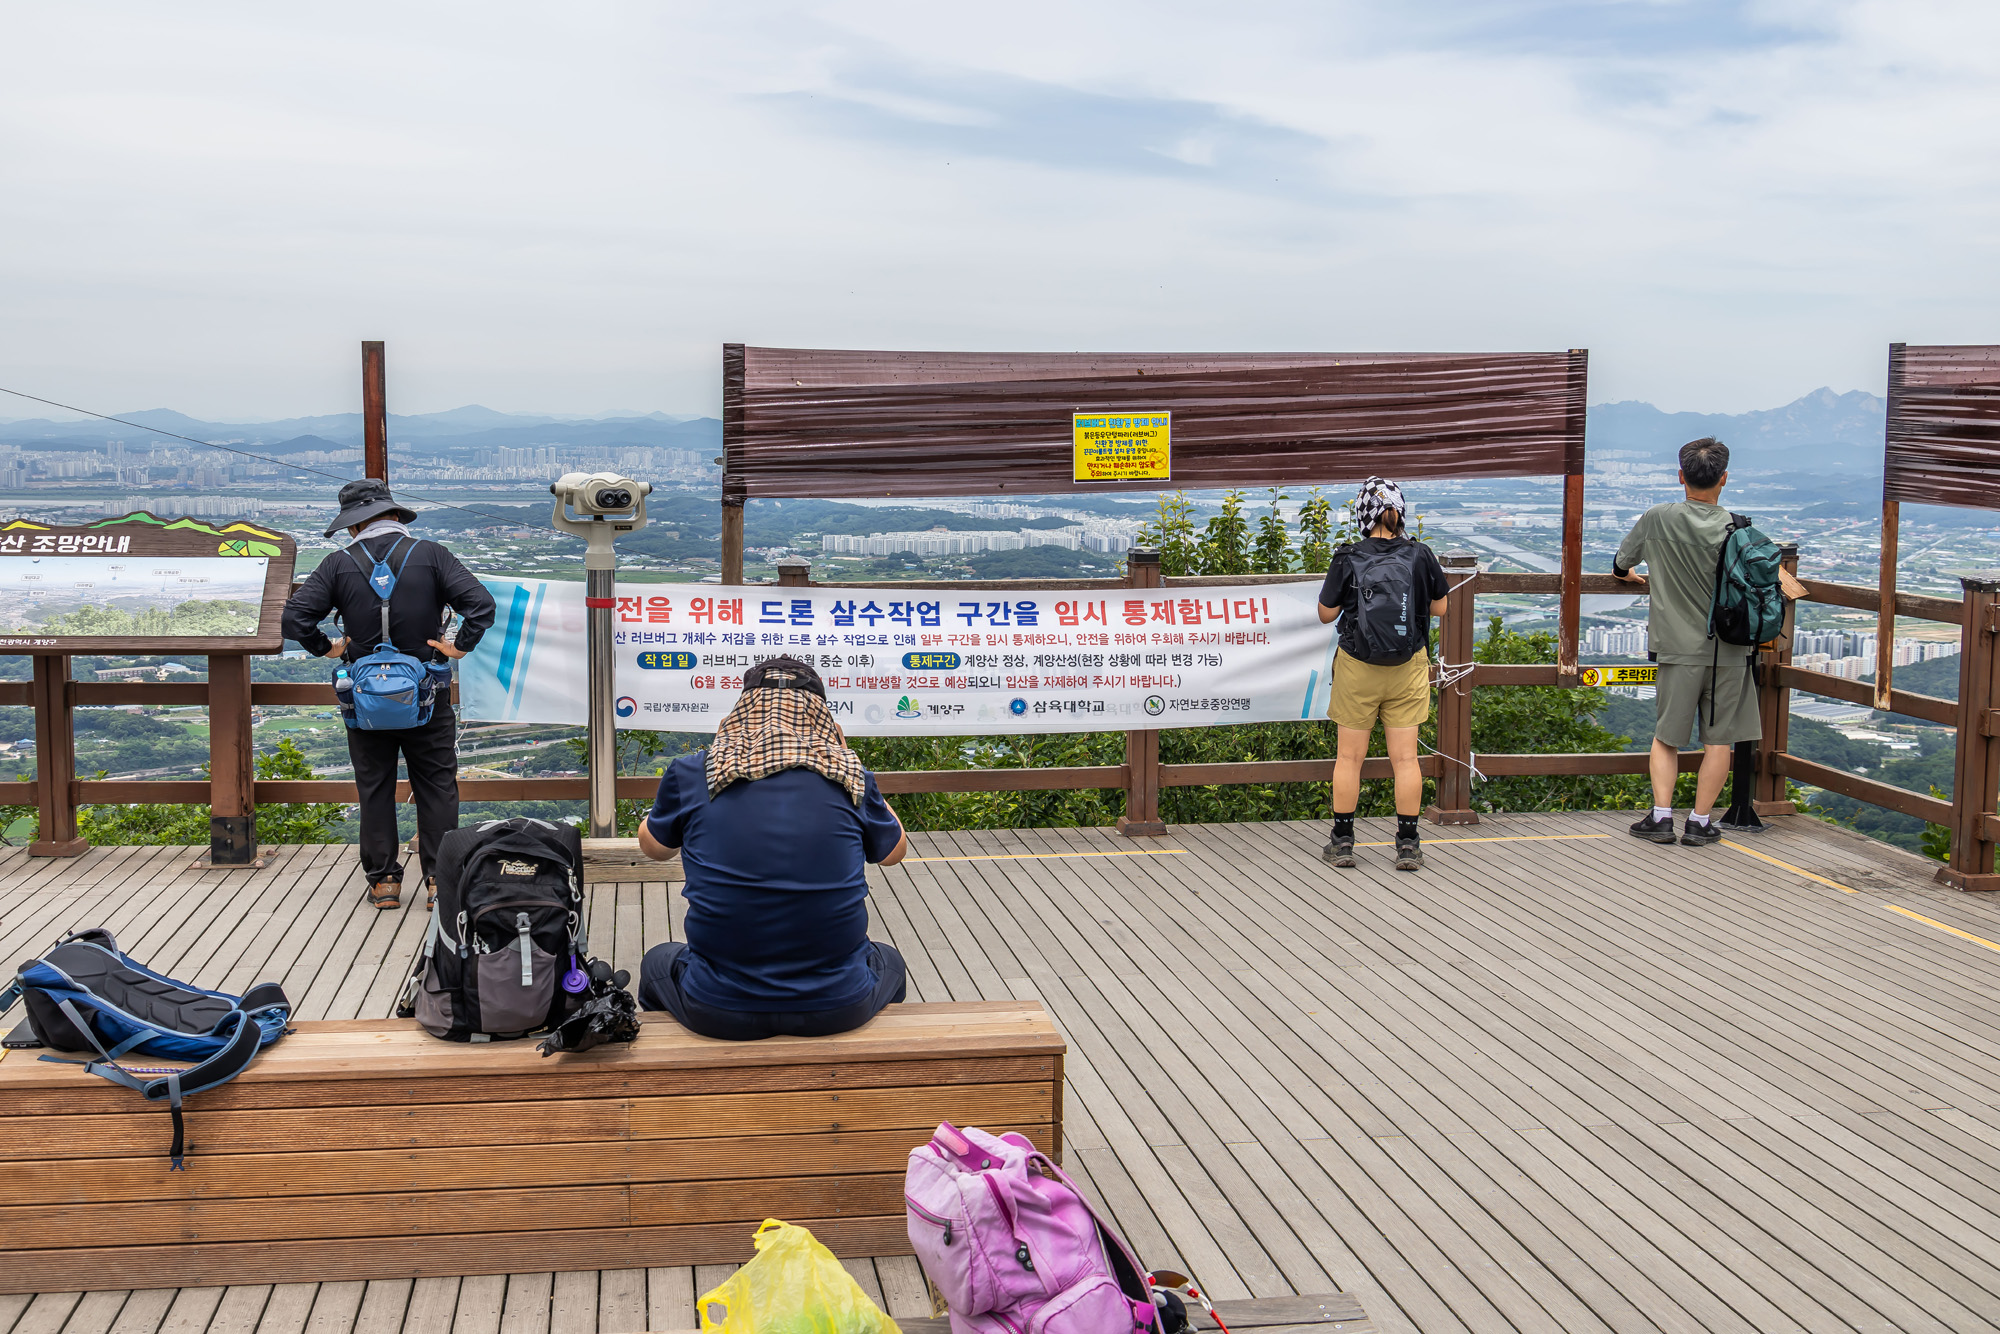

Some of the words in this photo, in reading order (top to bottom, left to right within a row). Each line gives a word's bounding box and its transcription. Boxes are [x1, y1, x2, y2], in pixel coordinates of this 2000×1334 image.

[1076, 418, 1107, 428] 러브버그
[1108, 418, 1131, 428] 친환경
[1133, 418, 1149, 428] 방제
[1151, 418, 1168, 428] 안내
[0, 535, 27, 552] 산
[30, 536, 131, 552] 조망안내
[616, 596, 672, 624] 전을
[688, 597, 743, 626] 위해
[758, 599, 815, 626] 드론
[830, 600, 941, 627] 살수작업
[956, 601, 1040, 626] 구간을
[1054, 600, 1108, 626] 임시
[1122, 598, 1270, 626] 통제합니다!
[1400, 592, 1408, 622] deuter
[631, 632, 678, 645] 러브버그
[682, 632, 717, 646] 개체수
[722, 632, 756, 646] 저감을
[760, 632, 784, 646] 위한
[788, 633, 812, 646] 드론
[815, 633, 839, 646] 살수
[843, 634, 889, 646] 작업으로
[893, 634, 916, 646] 인해
[920, 634, 943, 646] 일부
[947, 634, 981, 646] 구간을
[986, 634, 1008, 646] 임시
[1012, 633, 1072, 646] 통제하오니,
[1076, 633, 1110, 646] 안전을
[1114, 632, 1147, 646] 위하여
[1151, 632, 1184, 646] 우회해
[1188, 632, 1220, 645] 주시기
[1225, 632, 1271, 645] 바랍니다.
[702, 654, 749, 667] 러브버그
[819, 654, 843, 668] 중순
[847, 654, 875, 668] 이후)
[909, 654, 956, 668] 통제구간
[964, 654, 998, 668] 계양산
[1002, 654, 1029, 668] 정상,
[1033, 654, 1104, 668] 계양산성(현장
[1108, 654, 1141, 667] 상황에
[1145, 653, 1167, 667] 따라
[1171, 653, 1193, 667] 변경
[1197, 653, 1223, 667] 가능)
[690, 675, 715, 690] (6월
[856, 676, 901, 689] 대발생할
[906, 676, 940, 689] 것으로
[945, 676, 1001, 689] 예상되오니
[1005, 675, 1040, 689] 입산을
[1043, 675, 1088, 689] 자제하여
[1092, 675, 1126, 688] 주시기
[1130, 674, 1182, 688] 바랍니다.)
[643, 702, 710, 713] 국립생물자원관
[927, 704, 965, 715] 계양구
[1033, 700, 1105, 713] 삼육대학교
[1169, 698, 1251, 712] 자연보호중앙연맹
